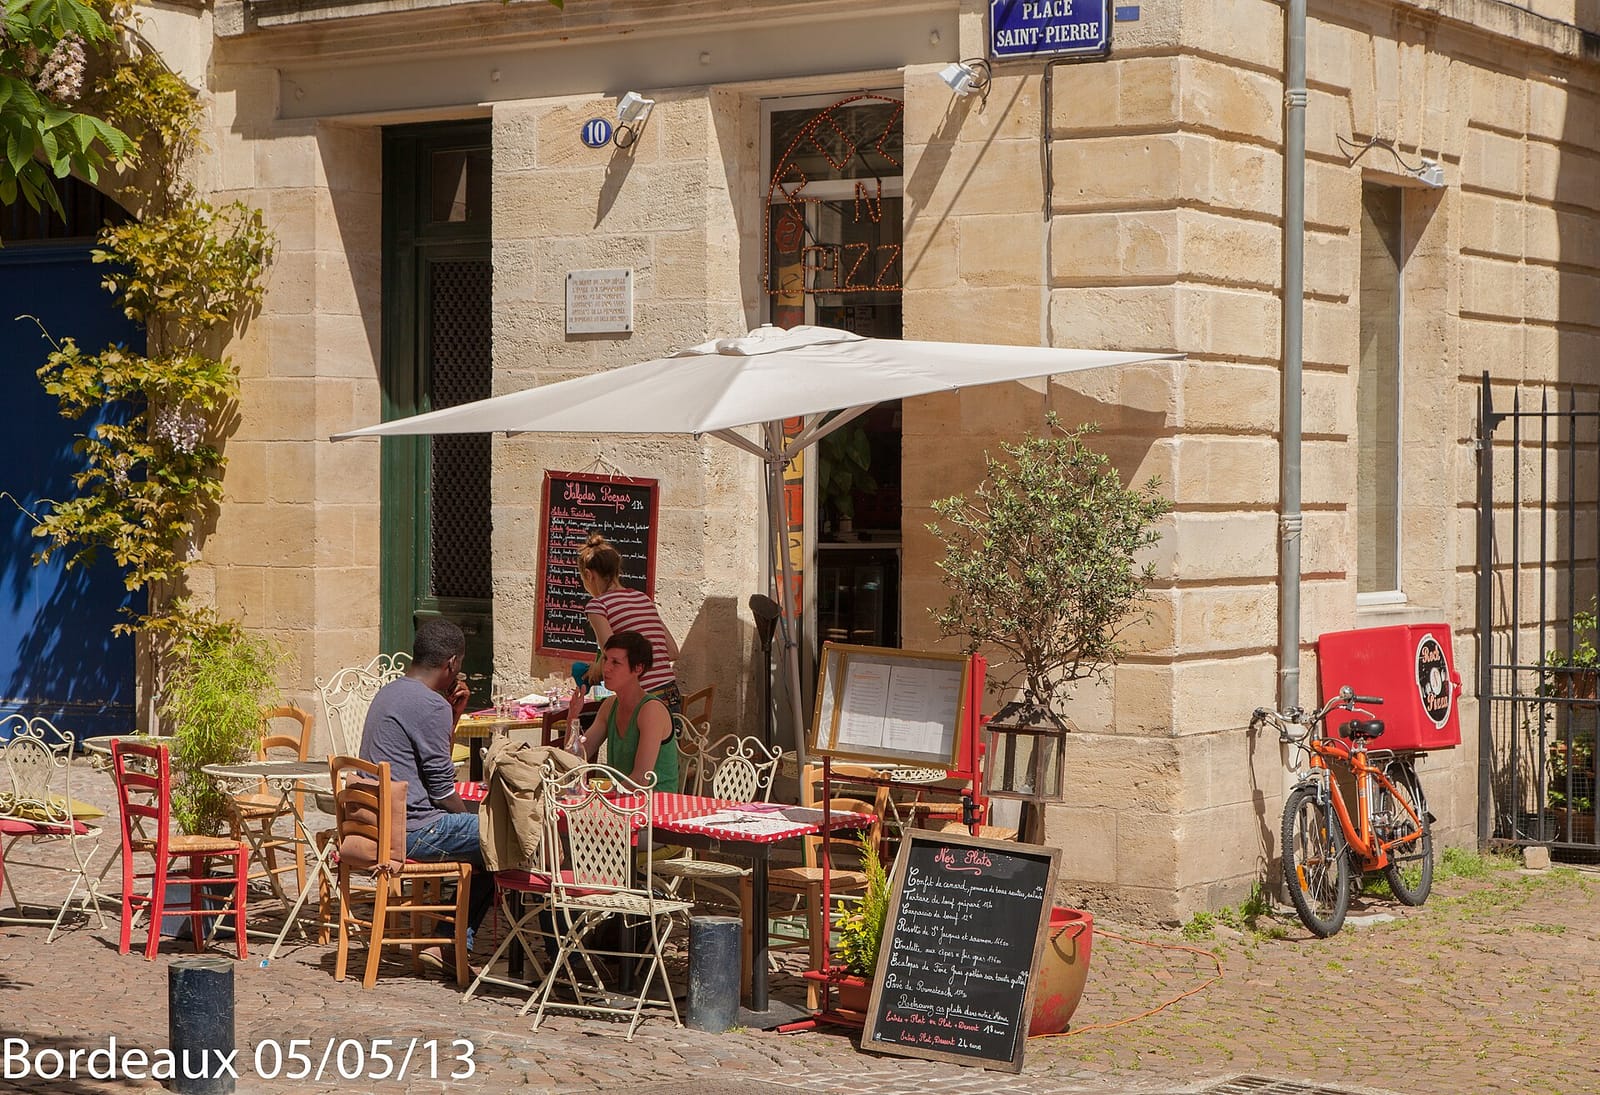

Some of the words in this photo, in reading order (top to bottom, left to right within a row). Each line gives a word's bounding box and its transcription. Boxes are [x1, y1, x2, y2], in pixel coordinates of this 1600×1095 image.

[1022, 0, 1073, 20] PLACE
[996, 22, 1099, 48] SAINT-PIERRE
[587, 120, 606, 144] 10
[801, 243, 902, 291] PIZZ
[1421, 645, 1441, 663] Rock
[1427, 692, 1448, 711] Pizza
[934, 847, 956, 864] Nos
[963, 849, 992, 867] Plats
[907, 867, 934, 893] Confit
